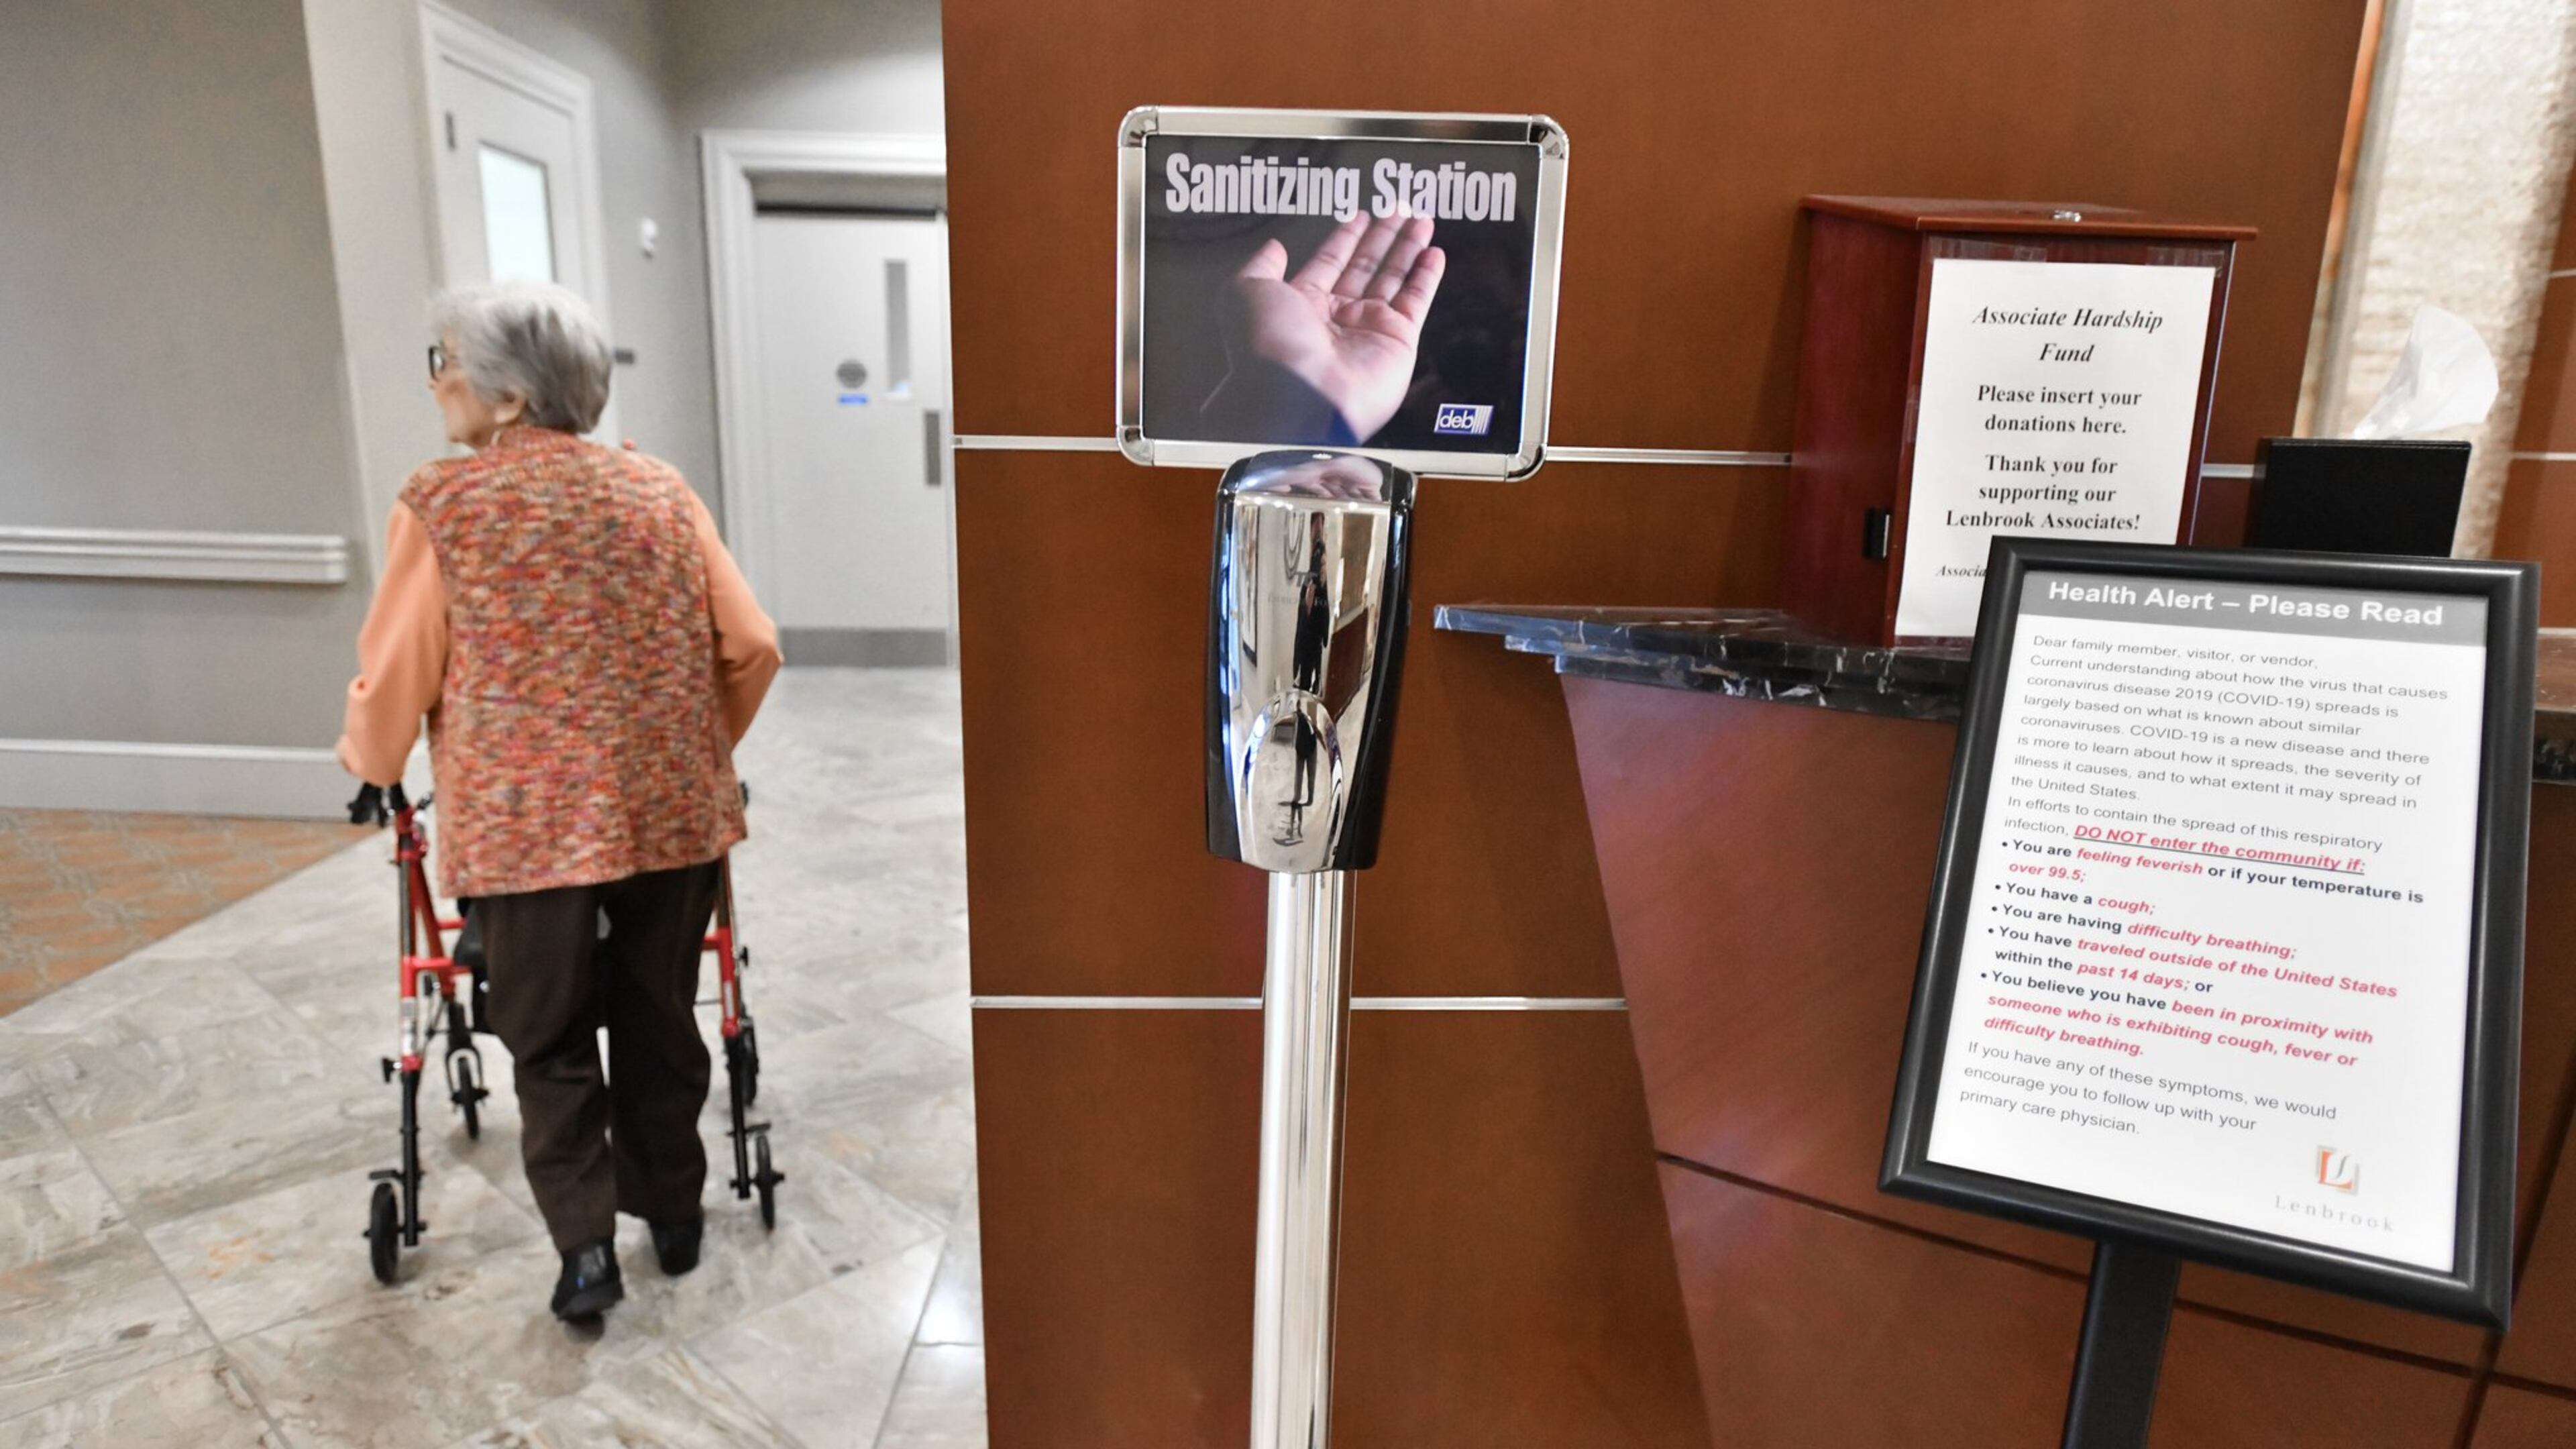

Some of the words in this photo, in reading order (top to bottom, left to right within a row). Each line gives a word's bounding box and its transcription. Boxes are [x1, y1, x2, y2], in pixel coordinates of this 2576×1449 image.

[1165, 152, 1359, 222] Sanitizing
[1373, 158, 1516, 221] Station
[1972, 306, 2067, 327] Associate
[2073, 309, 2163, 333] Hardship
[2039, 343, 2094, 363] Fund
[1978, 385, 2035, 403] Please
[2041, 387, 2094, 404] insert
[2098, 392, 2142, 409] your
[1440, 409, 1473, 429] deb
[1985, 415, 2076, 433] donations
[2082, 418, 2126, 434] here.
[1985, 454, 2045, 473] Thank
[2051, 458, 2086, 476] you
[2091, 458, 2118, 474] for
[1979, 485, 2079, 504] supporting
[2084, 488, 2116, 502] our
[1946, 511, 2035, 529] Lenbrook
[2041, 513, 2140, 530] Associates!
[2049, 582, 2136, 604] Health
[2144, 588, 2214, 610] Alert
[2249, 594, 2350, 619] Please
[2361, 600, 2443, 625] Read
[2033, 635, 2066, 647] Dear
[2072, 638, 2112, 653] family
[2027, 678, 2108, 691] coronavirus
[2113, 683, 2170, 696] disease
[2175, 688, 2213, 701] 2019
[2218, 692, 2310, 711] (COVID-19)
[2315, 702, 2379, 715] spreads
[2030, 655, 2082, 669] Current
[2087, 661, 2190, 680] understanding
[2195, 670, 2237, 682] about
[2243, 673, 2275, 685] how
[2279, 676, 2304, 688] the
[2310, 681, 2347, 691] virus
[2353, 682, 2382, 694] that
[2387, 687, 2447, 699] causes
[2024, 695, 2070, 710] largely
[2075, 699, 2119, 713] based
[2147, 706, 2182, 719] what
[2204, 711, 2253, 725] known
[2259, 716, 2302, 731] about
[2308, 723, 2361, 735] similar
[2021, 716, 2124, 736] coronaviruses.
[2130, 724, 2208, 743] COVID-19
[2245, 739, 2277, 749] new
[2282, 741, 2344, 756] disease
[2350, 749, 2381, 759] and
[2386, 750, 2429, 764] there
[2015, 755, 2058, 769] illness
[2137, 770, 2165, 781] and
[2190, 775, 2226, 788] what
[2231, 780, 2279, 794] extent
[2285, 784, 2294, 795] it
[2299, 788, 2334, 802] may
[2339, 792, 2396, 806] spread
[2402, 799, 2416, 808] in
[2033, 739, 2070, 749] more
[2092, 742, 2129, 755] learn
[2133, 747, 2176, 761] about
[2181, 751, 2212, 764] how
[2304, 764, 2329, 777] the
[2335, 769, 2399, 786] severity
[2011, 776, 2033, 787] the
[2038, 778, 2085, 794] United
[2090, 784, 2140, 801] States.
[2008, 796, 2021, 806] In
[2025, 798, 2070, 813] efforts
[2076, 804, 2089, 815] to
[2093, 808, 2147, 822] contain
[2153, 814, 2176, 826] the
[2182, 818, 2235, 833] spread
[2240, 824, 2256, 835] of
[2261, 826, 2288, 839] this
[2294, 832, 2382, 853] respiratory
[2074, 824, 2102, 839] DO
[2106, 828, 2147, 844] NOT
[2150, 837, 2196, 851] enter
[2201, 841, 2230, 855] the
[2235, 847, 2341, 868] community
[2346, 858, 2365, 871] if:
[2008, 863, 2044, 875] over
[2048, 866, 2086, 882] 99.5;
[2012, 839, 2042, 853] You
[2047, 846, 2072, 857] are
[2076, 847, 2131, 867] feeling
[2136, 855, 2203, 874] feverish
[2208, 867, 2226, 877] or
[2231, 867, 2243, 879] if
[2247, 872, 2286, 885] your
[2292, 875, 2402, 900] temperature
[2408, 890, 2424, 903] is
[2006, 882, 2036, 896] You
[2041, 887, 2078, 903] have
[2098, 898, 2155, 915] cough;
[2002, 904, 2033, 918] You
[2037, 912, 2062, 923] are
[2067, 913, 2122, 934] having
[2127, 923, 2202, 946] difficulty
[2206, 934, 2296, 959] breathing;
[1995, 950, 2042, 966] within
[2047, 957, 2073, 971] the
[2076, 963, 2114, 977] past
[2121, 968, 2139, 981] 14
[2143, 972, 2190, 990] days;
[2194, 982, 2213, 993] or
[1999, 925, 2029, 941] You
[2034, 931, 2072, 947] have
[2078, 938, 2145, 958] traveled
[2149, 951, 2213, 969] outside
[2218, 961, 2237, 972] of
[2241, 963, 2268, 977] the
[2274, 967, 2334, 987] United
[2339, 977, 2397, 998] States
[1992, 970, 2022, 986] You
[2027, 976, 2085, 996] believe
[2089, 989, 2121, 1002] you
[2126, 991, 2166, 1010] have
[2171, 1000, 2214, 1017] been
[2219, 1008, 2236, 1021] in
[2240, 1014, 2328, 1038] proximity
[2334, 1028, 2373, 1044] with
[1984, 1017, 2055, 1041] difficulty
[2059, 1029, 2143, 1057] breathing.
[1988, 996, 2062, 1016] someone
[2068, 1009, 2101, 1023] who
[2106, 1014, 2121, 1026] is
[2126, 1019, 2212, 1044] exhibiting
[2284, 1042, 2332, 1061] fever
[2337, 1055, 2357, 1066] or
[1964, 1067, 2045, 1091] encourage
[2049, 1083, 2078, 1096] you
[2083, 1087, 2098, 1100] to
[2103, 1090, 2149, 1110] follow
[2155, 1103, 2175, 1117] up
[2180, 1108, 2213, 1122] with
[2219, 1115, 2256, 1130] your
[1968, 1041, 1978, 1053] If
[1982, 1047, 2009, 1059] you
[2014, 1049, 2051, 1067] have
[2055, 1060, 2085, 1075] any
[2089, 1065, 2105, 1077] of
[2110, 1067, 2153, 1085] these
[2255, 1096, 2279, 1109] we
[2285, 1101, 2336, 1119] would
[1960, 1091, 2017, 1112] primary
[2022, 1102, 2055, 1117] care
[2060, 1109, 2139, 1134] physician.
[2275, 1195, 2394, 1232] Lenbrook
